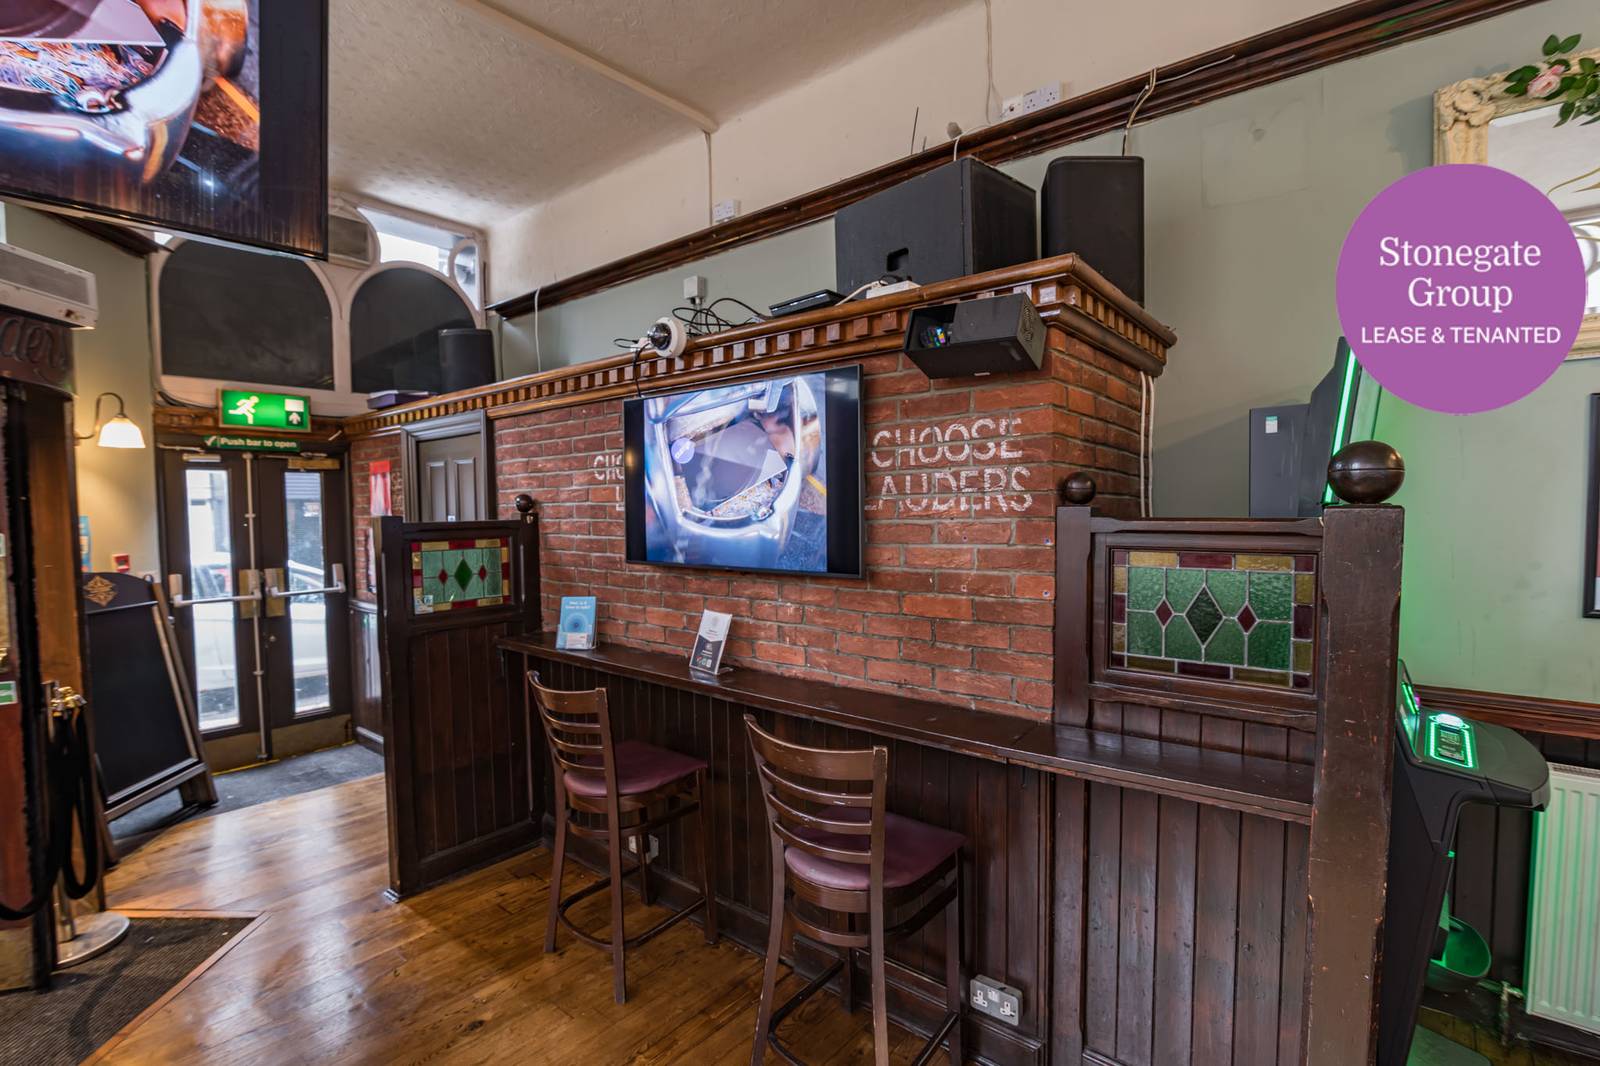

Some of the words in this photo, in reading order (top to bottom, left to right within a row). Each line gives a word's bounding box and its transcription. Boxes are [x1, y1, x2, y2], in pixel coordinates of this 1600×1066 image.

[220, 437, 245, 446] Push
[246, 438, 262, 447] bar
[263, 439, 273, 448] to
[274, 441, 297, 449] open
[871, 417, 1024, 468] CHOOSE
